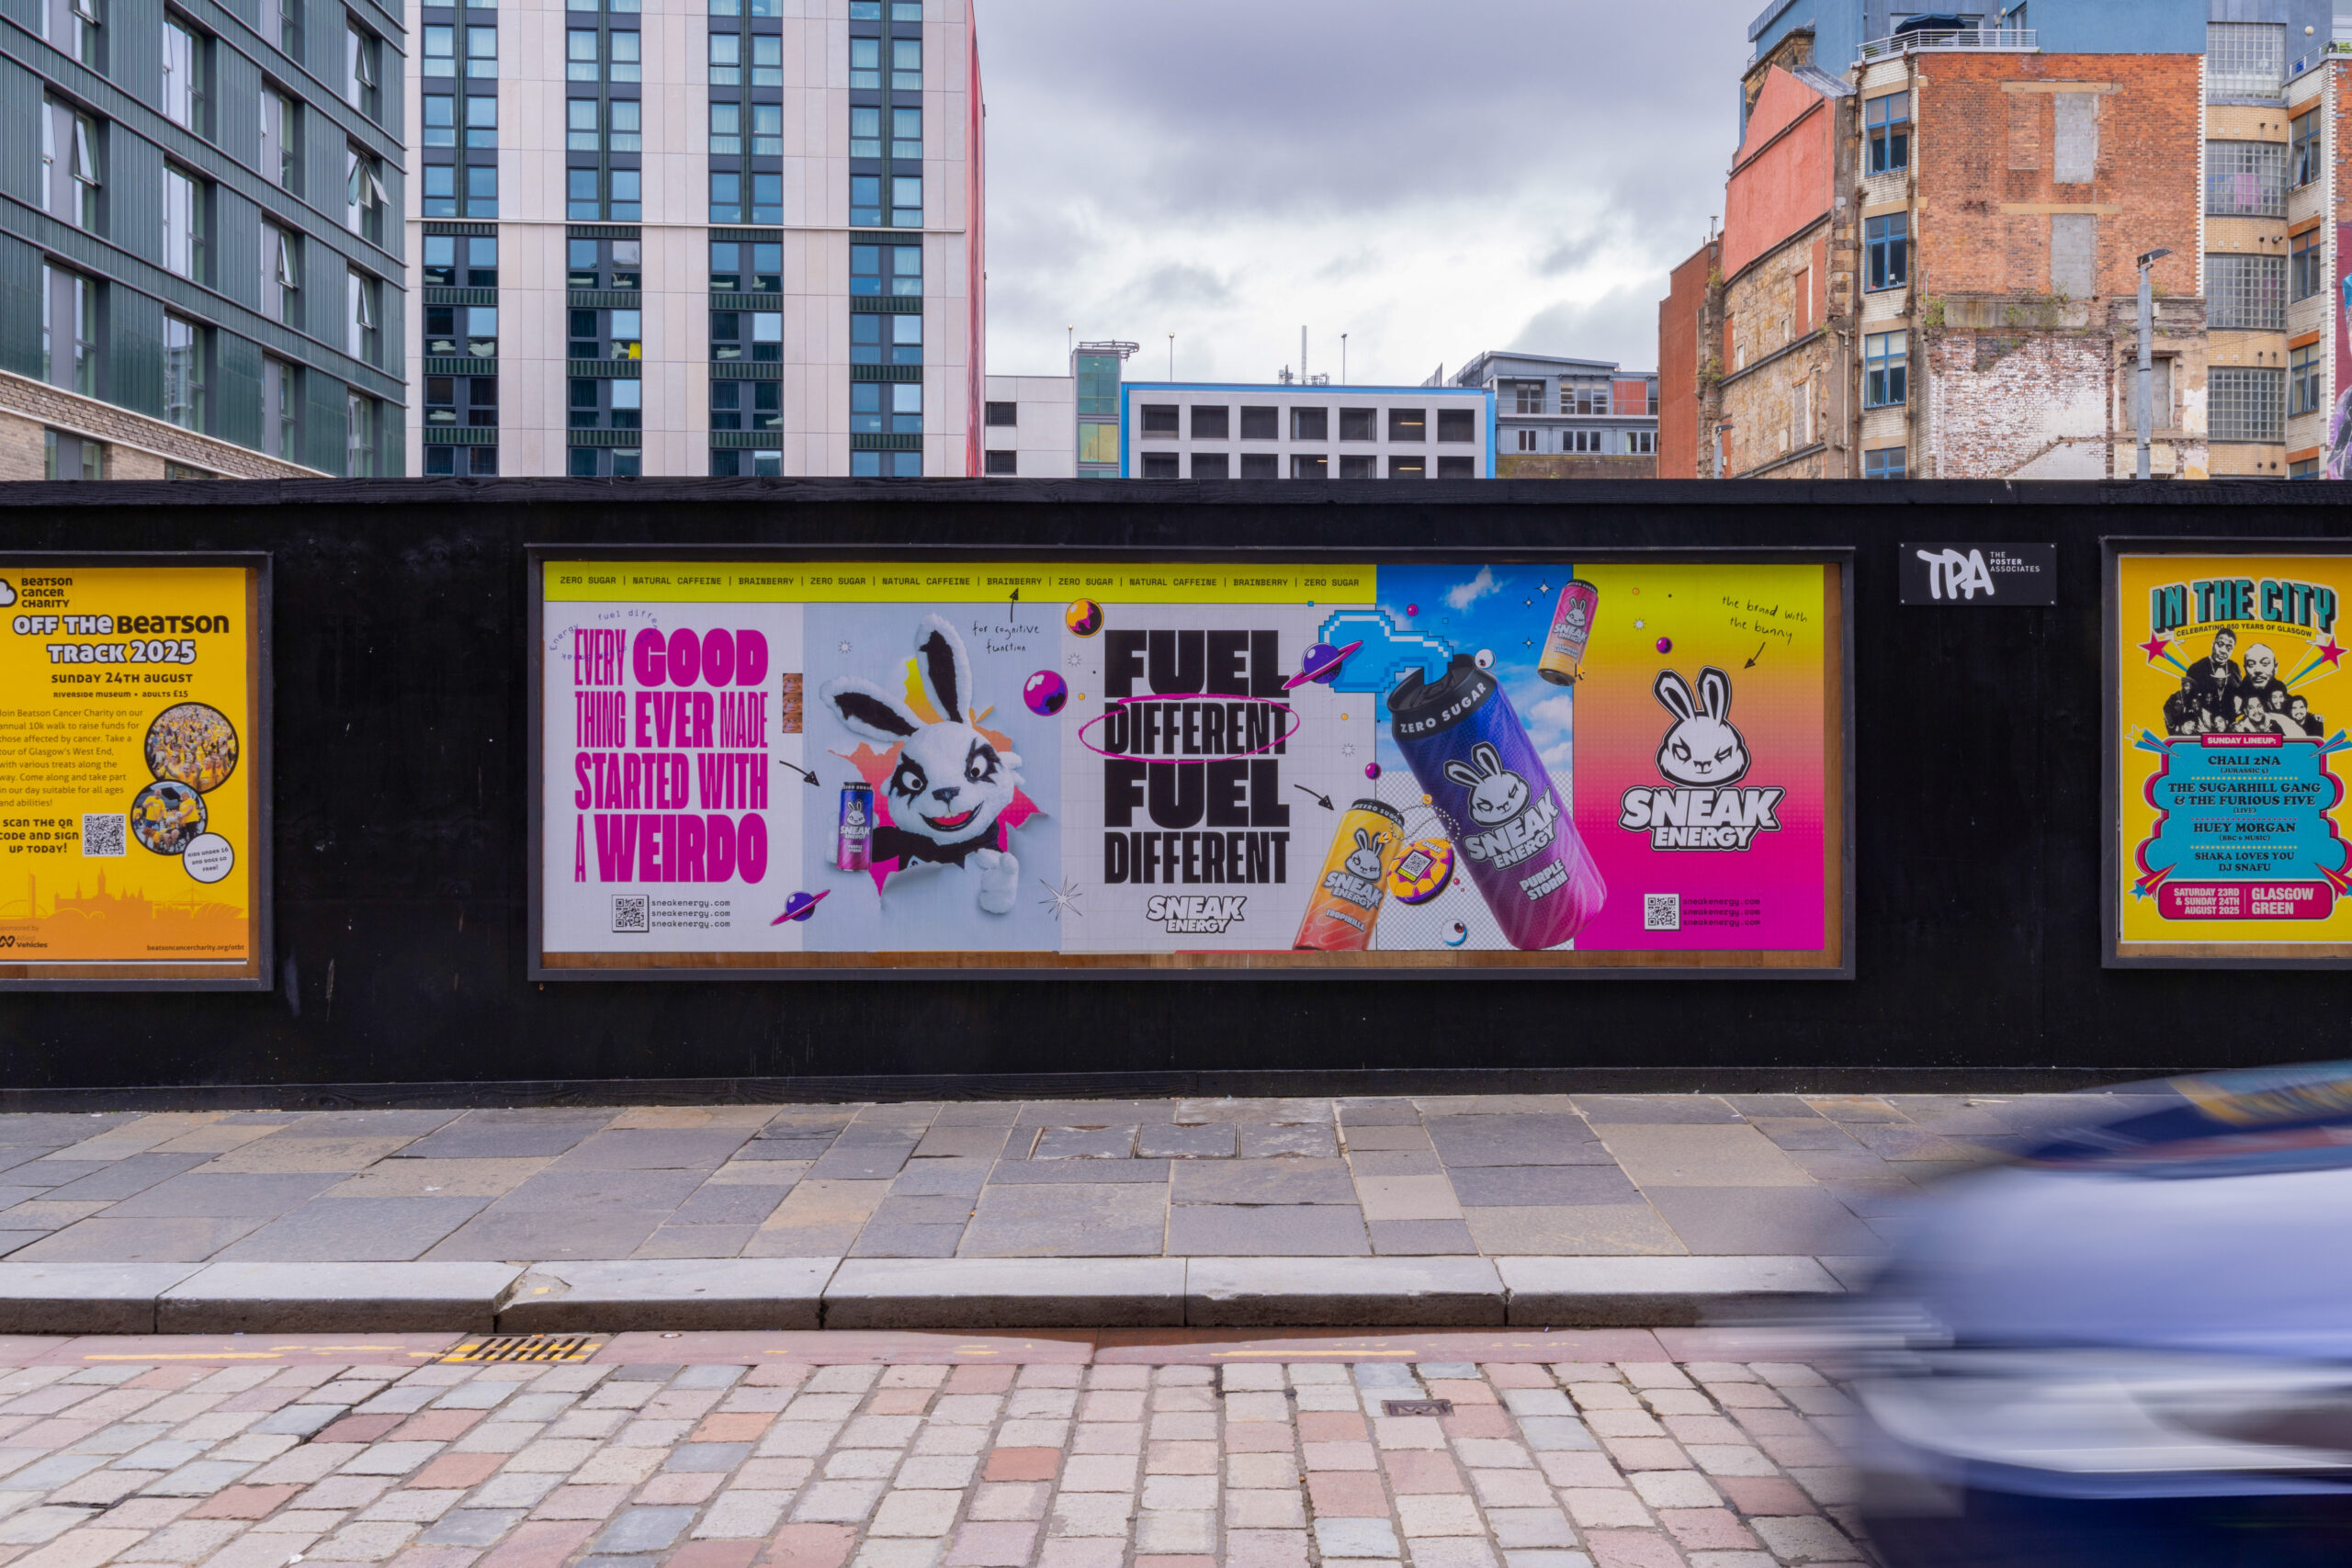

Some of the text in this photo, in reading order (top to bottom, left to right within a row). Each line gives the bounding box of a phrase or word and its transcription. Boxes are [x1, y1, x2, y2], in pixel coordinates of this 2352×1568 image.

[1917, 548, 1996, 600] TPA
[560, 576, 1360, 587] ZERO SUGAR NATURAL CAFFEINE BRAINBERRY ZERO SUGAR NATURAL CAFFEINE BRAINBERRY ZERO SUGAR NATURAL CAFFEINE BRAINBERRY ZERO SUGAR
[1722, 595, 1808, 623] the brand with
[2152, 580, 2336, 635] IN THE CITY
[12, 615, 60, 636] OFF
[972, 620, 1040, 640] for cognitive
[1553, 623, 1588, 642] SNEAK
[1729, 616, 1792, 647] the bunny
[2176, 624, 2224, 637] CELEBRATING
[2277, 626, 2312, 637] GLASGOW
[130, 639, 197, 665] 2025
[986, 638, 1026, 655] function
[574, 627, 769, 688] EVERY GOOD
[1104, 629, 1290, 700] FUEL
[106, 671, 140, 684] 24TH
[173, 690, 188, 698] £15
[17, 708, 51, 717] Beatson
[52, 708, 82, 717] Cancer
[84, 708, 114, 719] Charity
[1400, 682, 1487, 734] ZERO SUGAR
[29, 721, 44, 730] 10k
[46, 721, 66, 730] walk
[79, 721, 99, 730] raise
[101, 721, 125, 729] funds
[127, 721, 140, 729] for
[574, 691, 768, 749] THING EVER MADE
[1104, 702, 1290, 755] DIFFERENT
[24, 734, 59, 743] affected
[61, 734, 71, 745] by
[106, 735, 125, 743] Take
[2207, 737, 2277, 745] SUNDAY LINEUP:
[18, 747, 115, 758] of Glasgow's West End,
[2208, 755, 2281, 766] CHALI 2NA
[2220, 767, 2260, 775] (JURASSIC
[574, 751, 768, 810] STARTED WITH
[1104, 759, 1290, 829] FUEL
[2168, 783, 2322, 793] THE SUGARHILL GANG
[2174, 795, 2316, 806] & THE FURIOUS FIVE
[1621, 788, 1782, 828] SNEAK
[58, 818, 74, 829] QR
[1464, 787, 1560, 862] SNEAK
[2193, 822, 2297, 833] HUEY MORGAN
[840, 826, 871, 836] SNEAK
[1654, 827, 1753, 848] ENERGY
[574, 812, 768, 885] A WEIRDO
[1494, 822, 1555, 870] ENERGY
[1104, 831, 1290, 884] DIFFERENT
[2195, 852, 2295, 861] SHAKA LOVES YOU
[2219, 863, 2272, 872] DJ SNAFU
[1519, 858, 1566, 892] PURPLE
[1323, 871, 1384, 907] SNEAK
[1529, 870, 1570, 901] STORM
[2174, 887, 2240, 897] SATURDAY 23RD
[1332, 888, 1375, 911] ENERGY
[2251, 887, 2314, 901] GLASGOW
[651, 898, 731, 908] sneakenergy.com
[1147, 895, 1248, 921] SNEAK
[1682, 897, 1761, 908] sneakenergy.com
[2176, 897, 2240, 906] & SUNDAY 24TH
[2251, 901, 2294, 915] GREEN
[651, 909, 731, 919] sneakenergy.com
[1682, 908, 1761, 918] sneakenergy.com
[2184, 906, 2240, 915] AUGUST 2025
[651, 919, 731, 930] sneakenergy.com
[1166, 919, 1231, 933] ENERGY
[1682, 918, 1761, 928] sneakenergy.com
